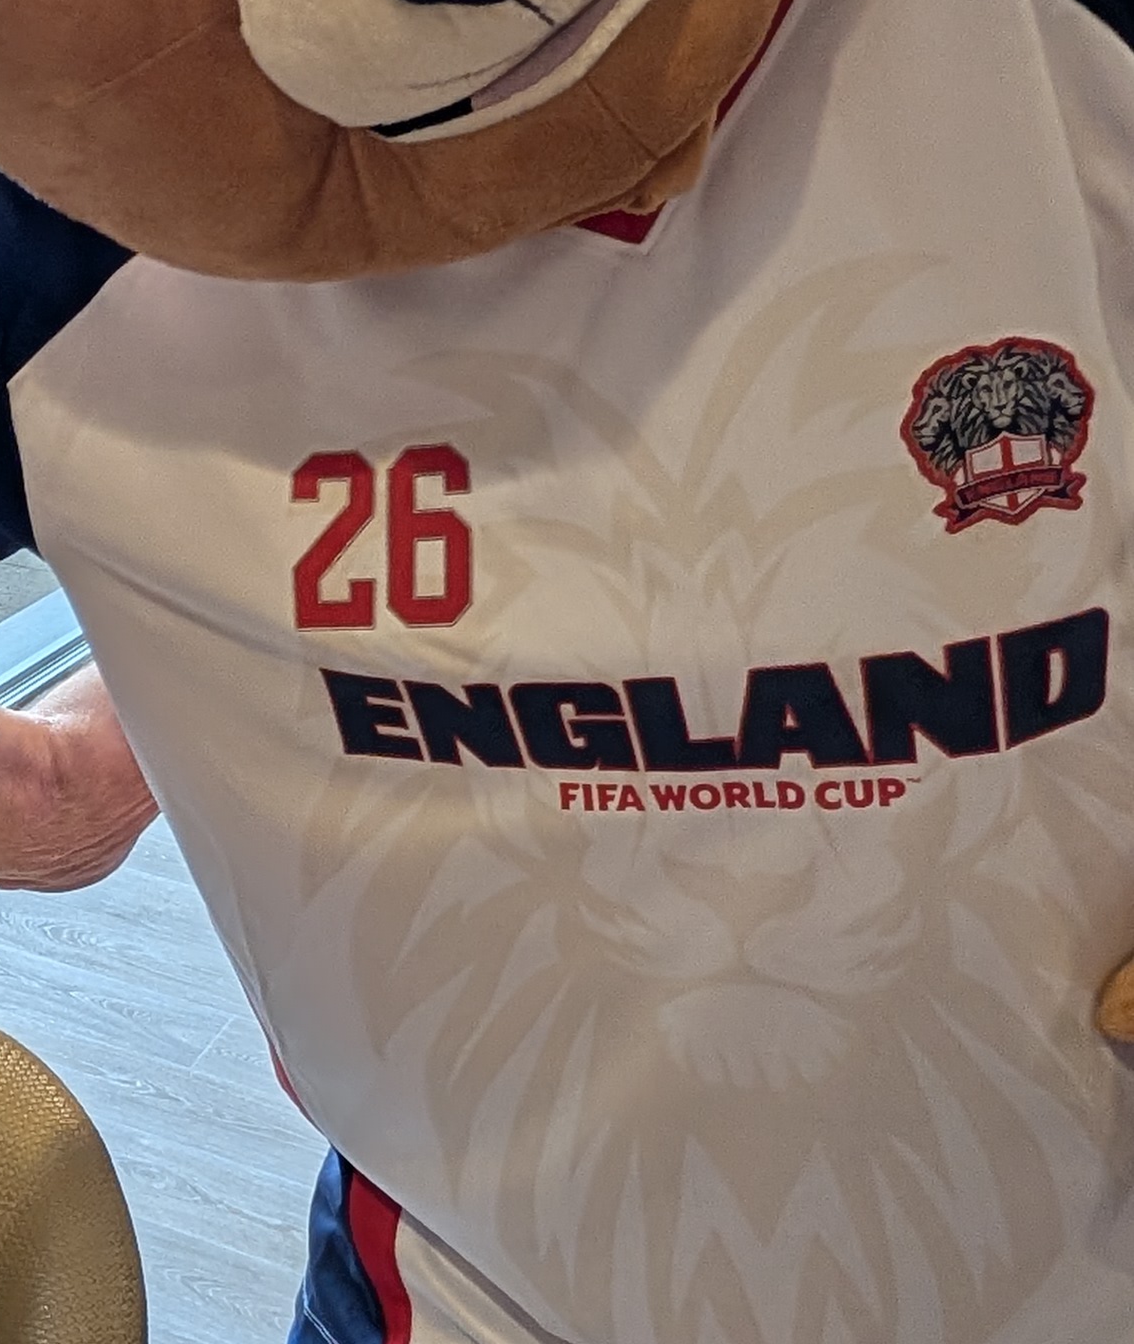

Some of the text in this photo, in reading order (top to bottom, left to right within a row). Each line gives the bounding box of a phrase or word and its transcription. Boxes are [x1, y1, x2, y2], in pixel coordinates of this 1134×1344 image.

[290, 443, 474, 631] 26
[319, 606, 1111, 773] ENGLAND
[558, 782, 645, 812] FIFA
[649, 780, 806, 812] WORLD
